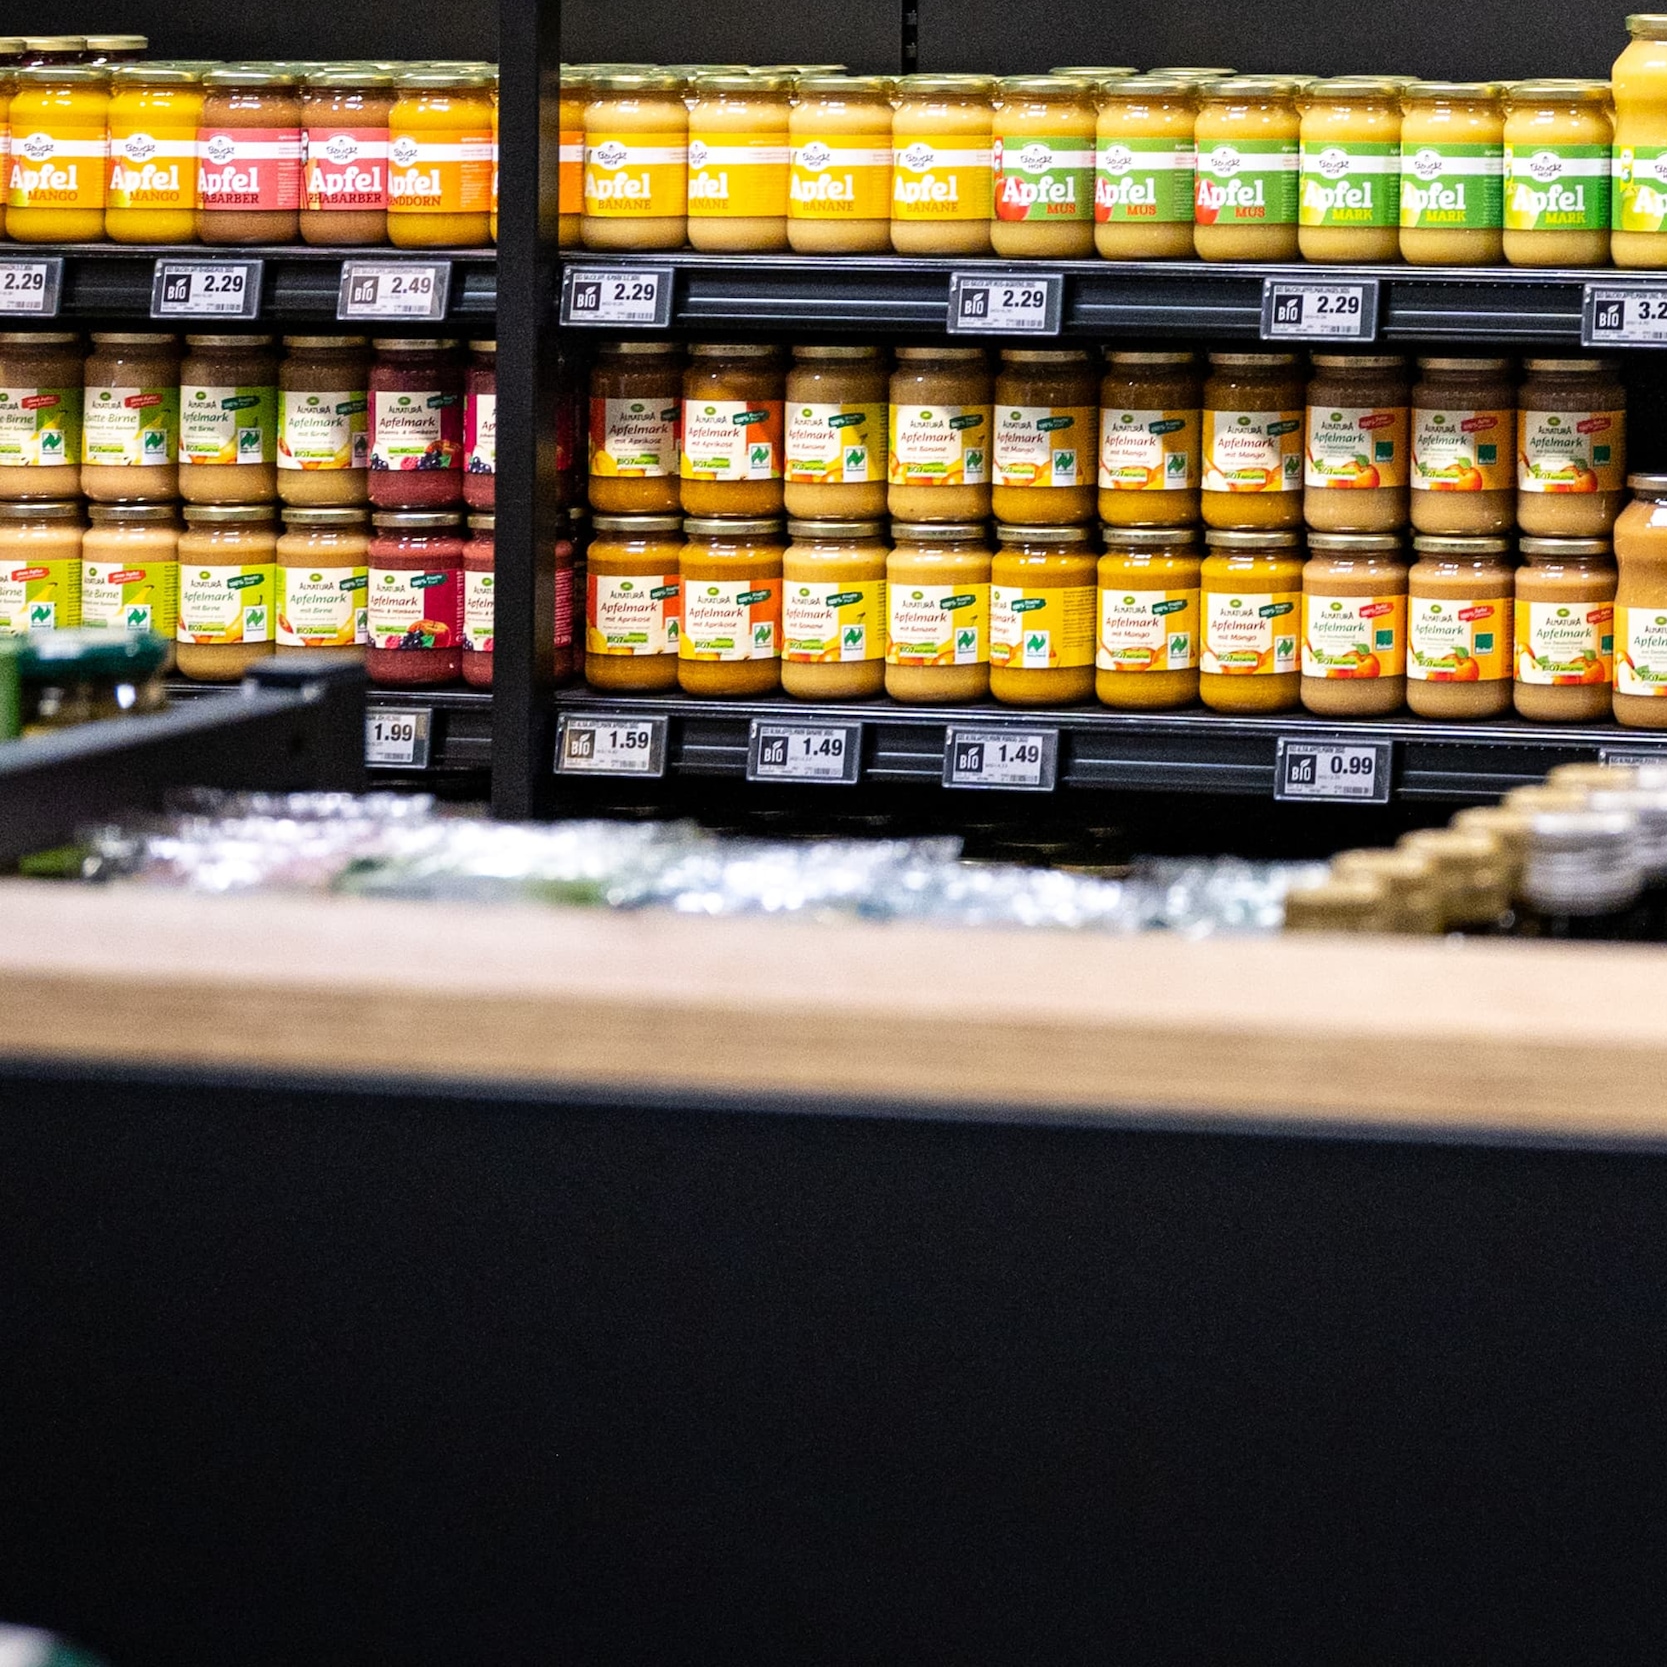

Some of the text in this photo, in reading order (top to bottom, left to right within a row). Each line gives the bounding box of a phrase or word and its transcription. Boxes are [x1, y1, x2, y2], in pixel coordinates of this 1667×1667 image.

[9, 164, 79, 195] Apfel
[109, 163, 180, 195] Apfel
[308, 166, 383, 197] Apfel
[585, 172, 652, 200] Apfel
[790, 173, 855, 201] Apfel
[27, 191, 79, 202] MANGO
[128, 191, 180, 202] MANGO
[893, 175, 959, 203] Apfel
[1002, 176, 1076, 206] Apfel
[1095, 177, 1157, 207] Apfel
[1197, 179, 1266, 208] Apfel
[1303, 181, 1373, 211] Apfel
[1402, 182, 1467, 211] Apfel
[1511, 183, 1586, 213] Apfel
[598, 199, 652, 210] BANANE
[803, 201, 855, 212] BANANE
[906, 202, 959, 213] BANANE
[1047, 203, 1076, 215] MUS
[1126, 204, 1157, 216] MUS
[1235, 206, 1265, 218] MUS
[1332, 209, 1373, 221] MARK
[1426, 209, 1466, 222] MARK
[1545, 211, 1587, 224] MARK
[5, 273, 43, 290] 2.29
[204, 275, 243, 292] 2.29
[392, 277, 431, 294] 2.49
[614, 283, 655, 301] 2.29
[1003, 290, 1044, 308] 2.29
[1317, 295, 1359, 314] 2.29
[374, 723, 412, 742] 1.99
[609, 731, 649, 750] 1.59
[802, 738, 843, 757] 1.49
[999, 744, 1040, 764] 1.49
[1330, 755, 1373, 776] 0.99
